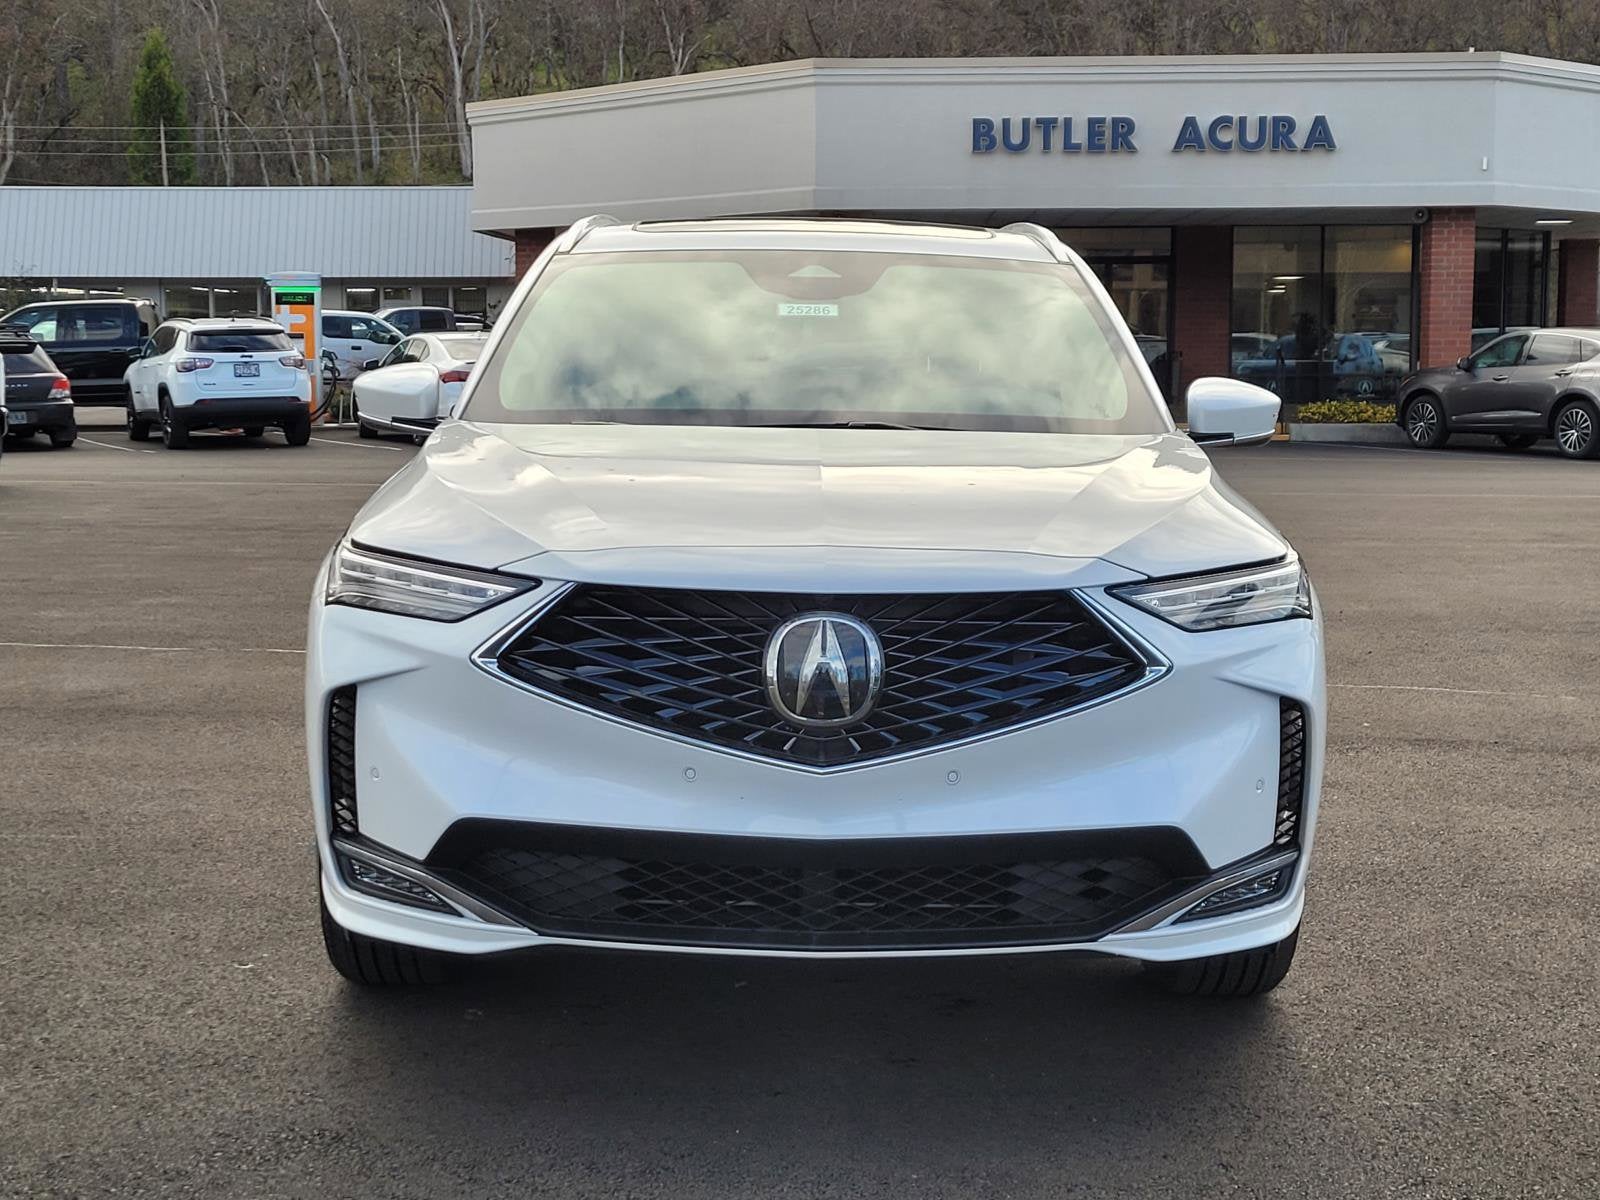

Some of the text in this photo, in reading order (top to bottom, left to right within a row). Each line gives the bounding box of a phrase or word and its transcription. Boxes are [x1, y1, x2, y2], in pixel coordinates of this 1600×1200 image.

[971, 115, 1338, 152] BUTLER ACURA
[786, 305, 831, 315] 25286
